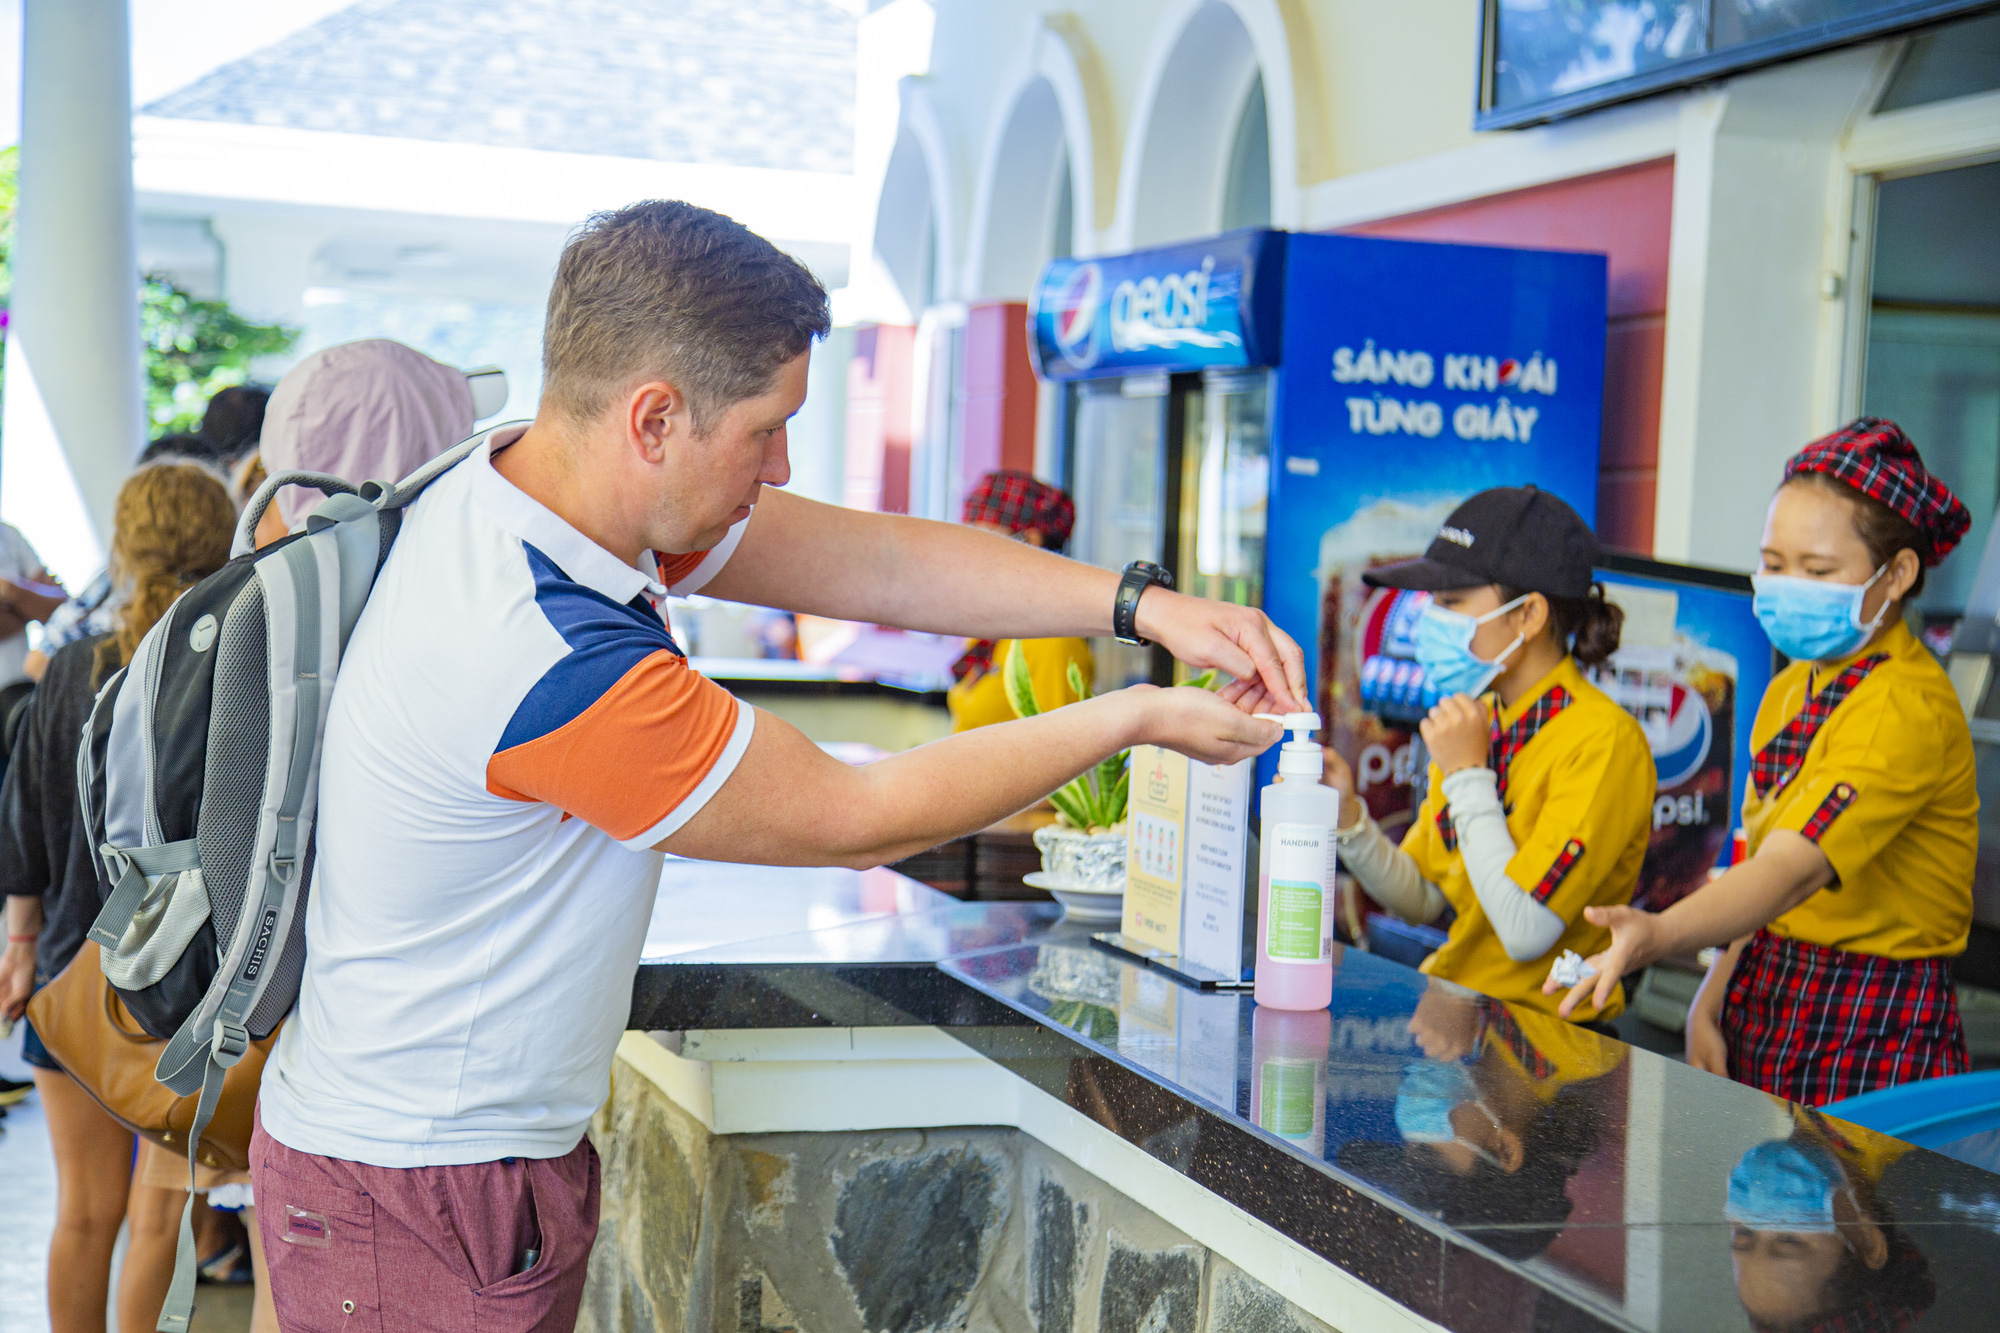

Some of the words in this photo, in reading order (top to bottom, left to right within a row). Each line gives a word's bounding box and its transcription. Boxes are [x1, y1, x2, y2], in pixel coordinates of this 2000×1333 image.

[1653, 789, 1704, 832] psi
[1280, 839, 1319, 848] HANDRUB
[248, 916, 274, 975] SACHIS
